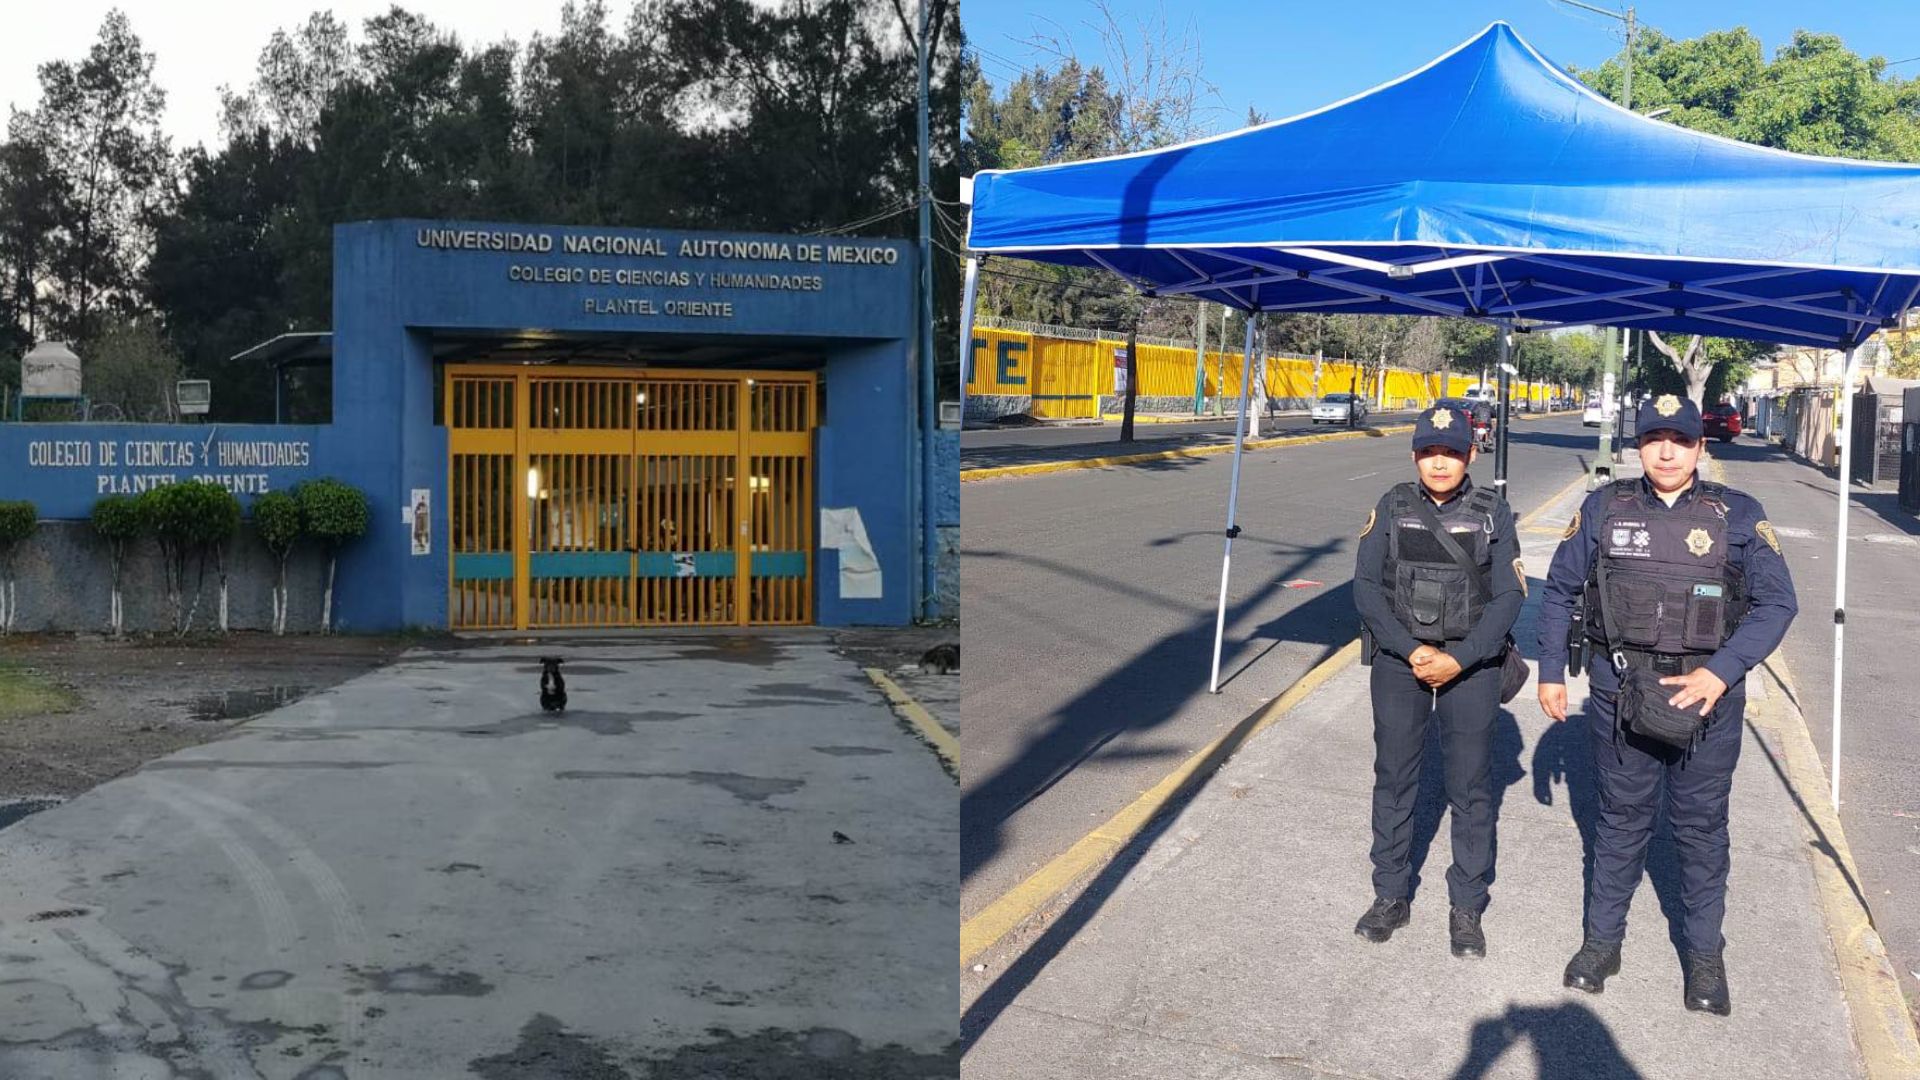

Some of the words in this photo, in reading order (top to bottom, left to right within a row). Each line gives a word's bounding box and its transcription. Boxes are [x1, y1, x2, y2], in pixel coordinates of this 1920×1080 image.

[417, 229, 553, 253] UNIVERSIDAD
[562, 235, 668, 257] NACIONAL
[679, 239, 792, 261] AUTONOMA
[797, 244, 823, 263] DE
[827, 245, 899, 265] MEXICO
[509, 265, 583, 283] COLEGIO
[589, 269, 612, 285] DE
[615, 269, 689, 286] CIENCIAS
[695, 273, 706, 288] Y
[710, 273, 823, 291] HUMANIDADES
[584, 297, 659, 315] PLANTEL
[664, 300, 733, 317] ORIENTE
[28, 440, 91, 467] COLEGIO
[99, 441, 118, 467] DE
[124, 441, 194, 466] CIENCIAS
[218, 441, 310, 467] HUMANIDADES
